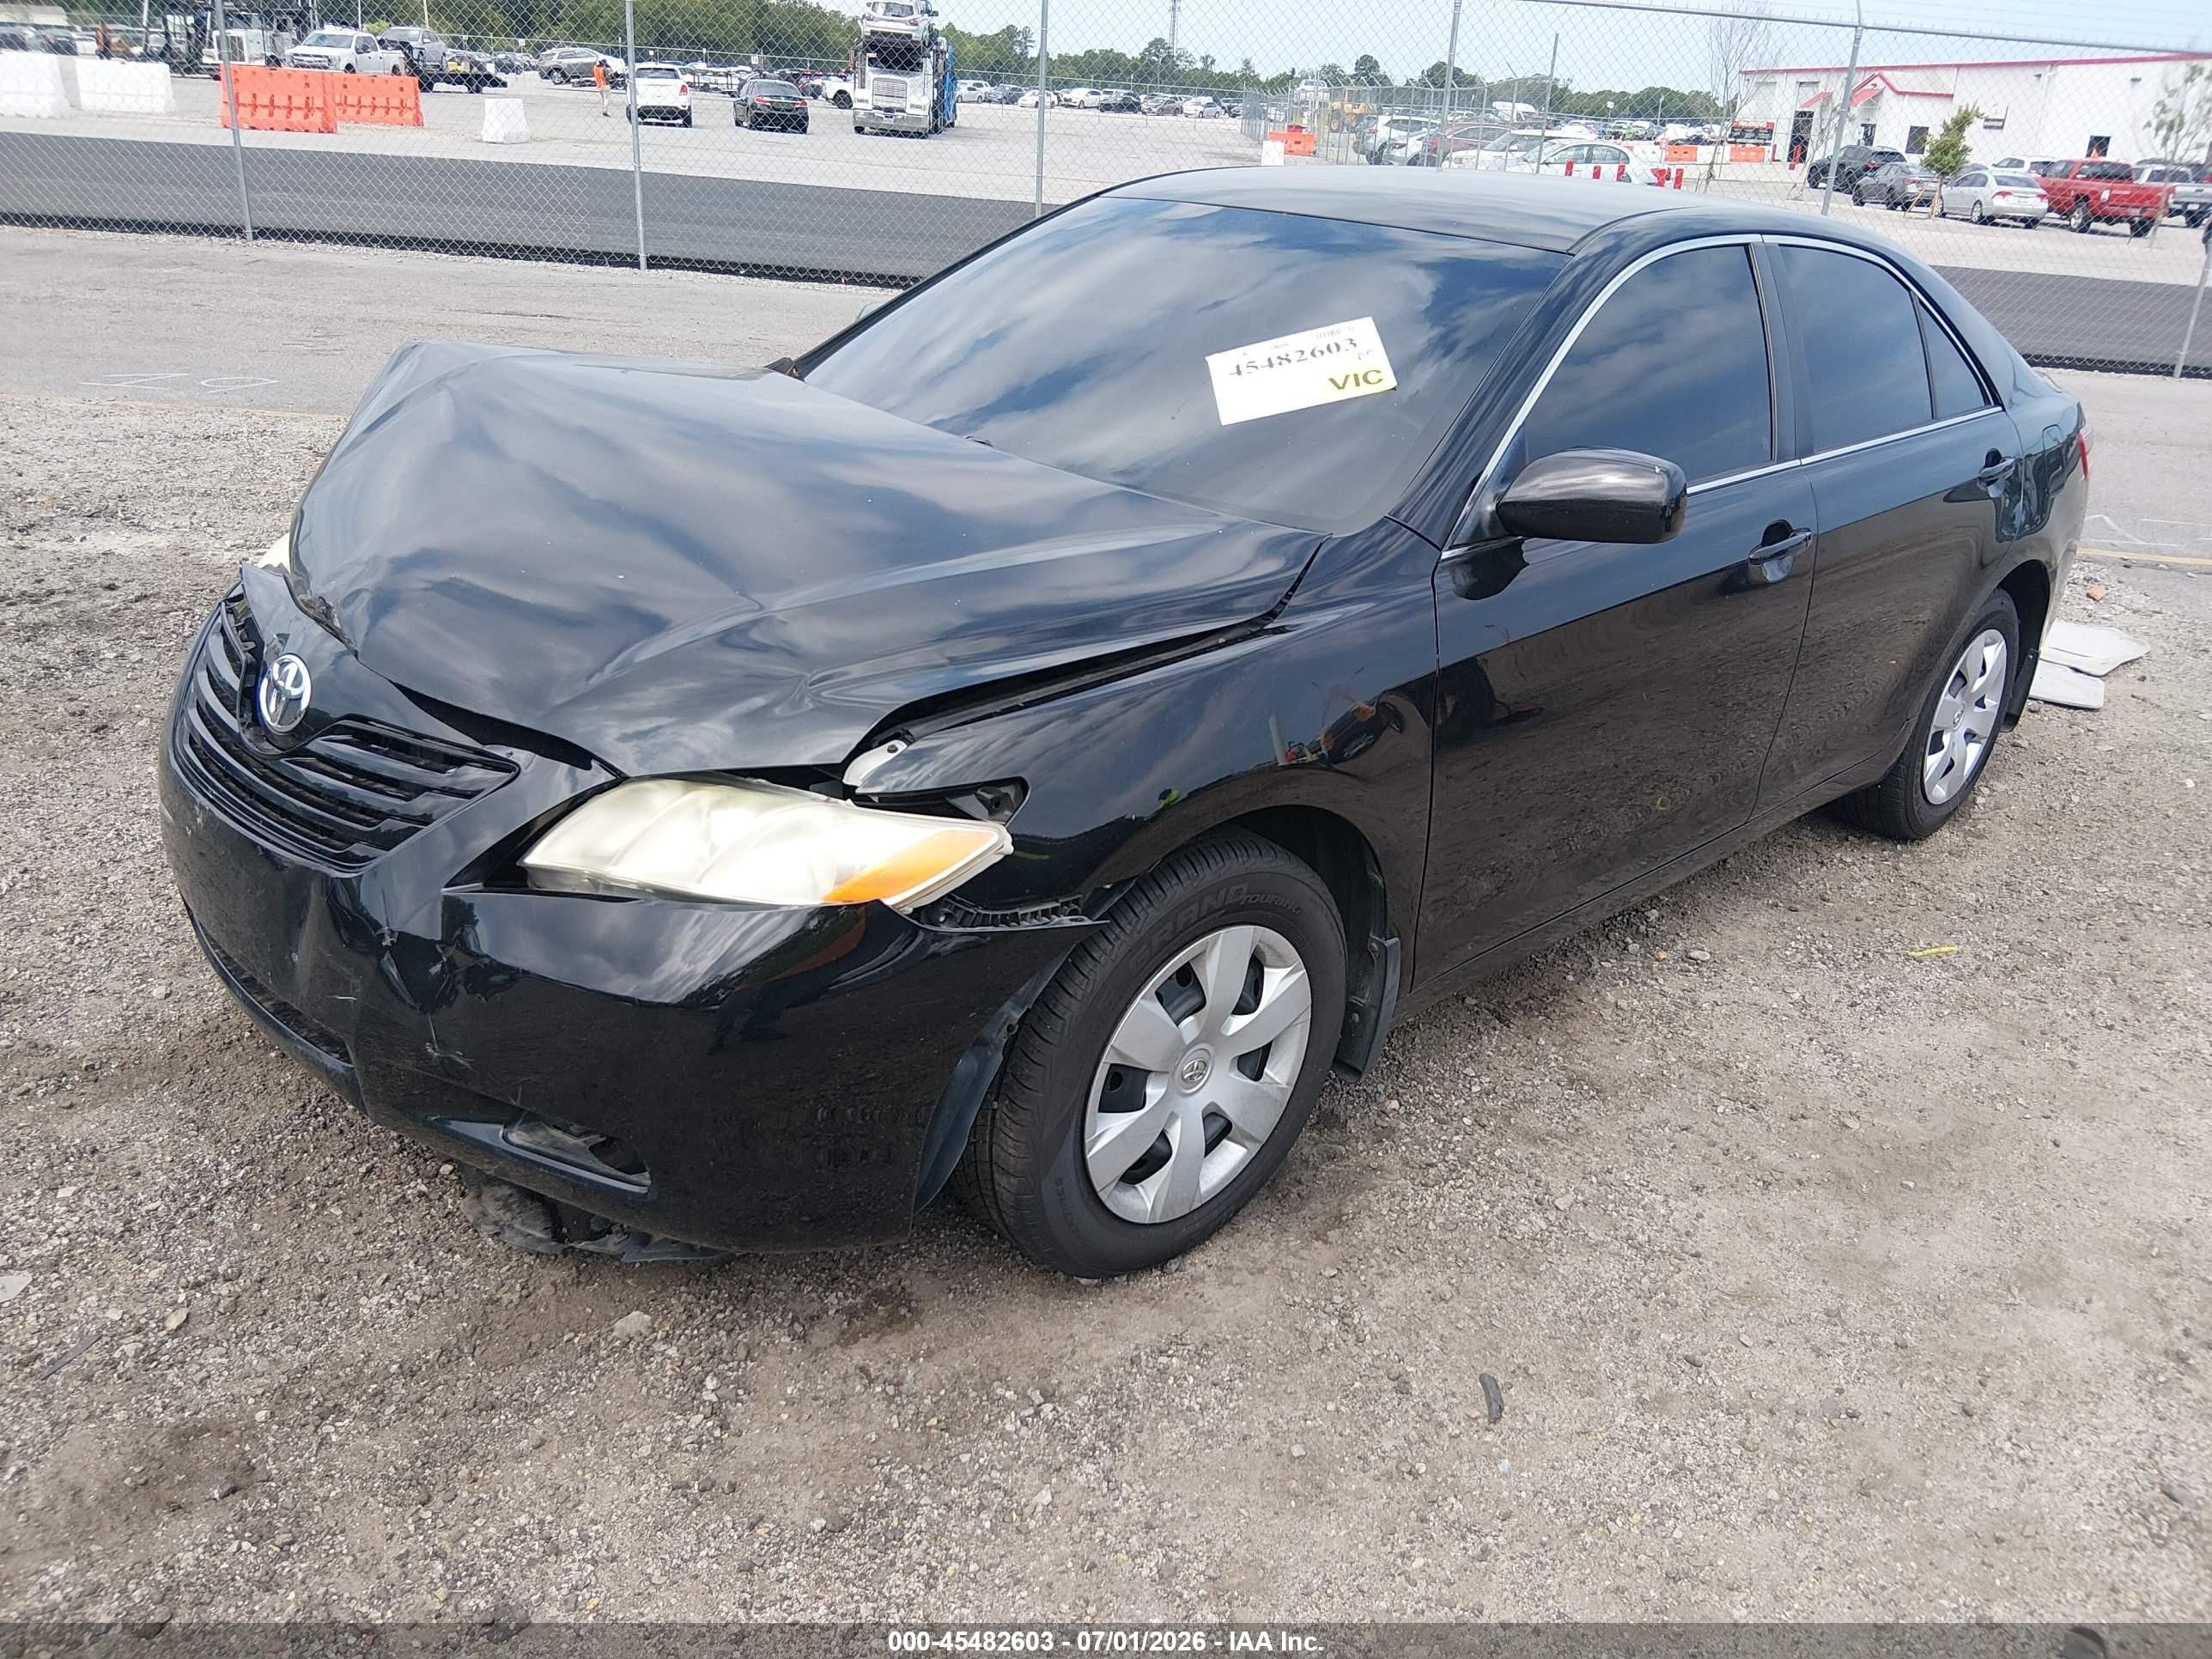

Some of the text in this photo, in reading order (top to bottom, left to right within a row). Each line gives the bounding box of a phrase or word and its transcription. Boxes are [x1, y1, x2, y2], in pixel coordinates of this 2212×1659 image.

[1229, 337, 1358, 376] 45482603
[1328, 369, 1384, 391] VIC
[1241, 892, 1304, 915] TOURING
